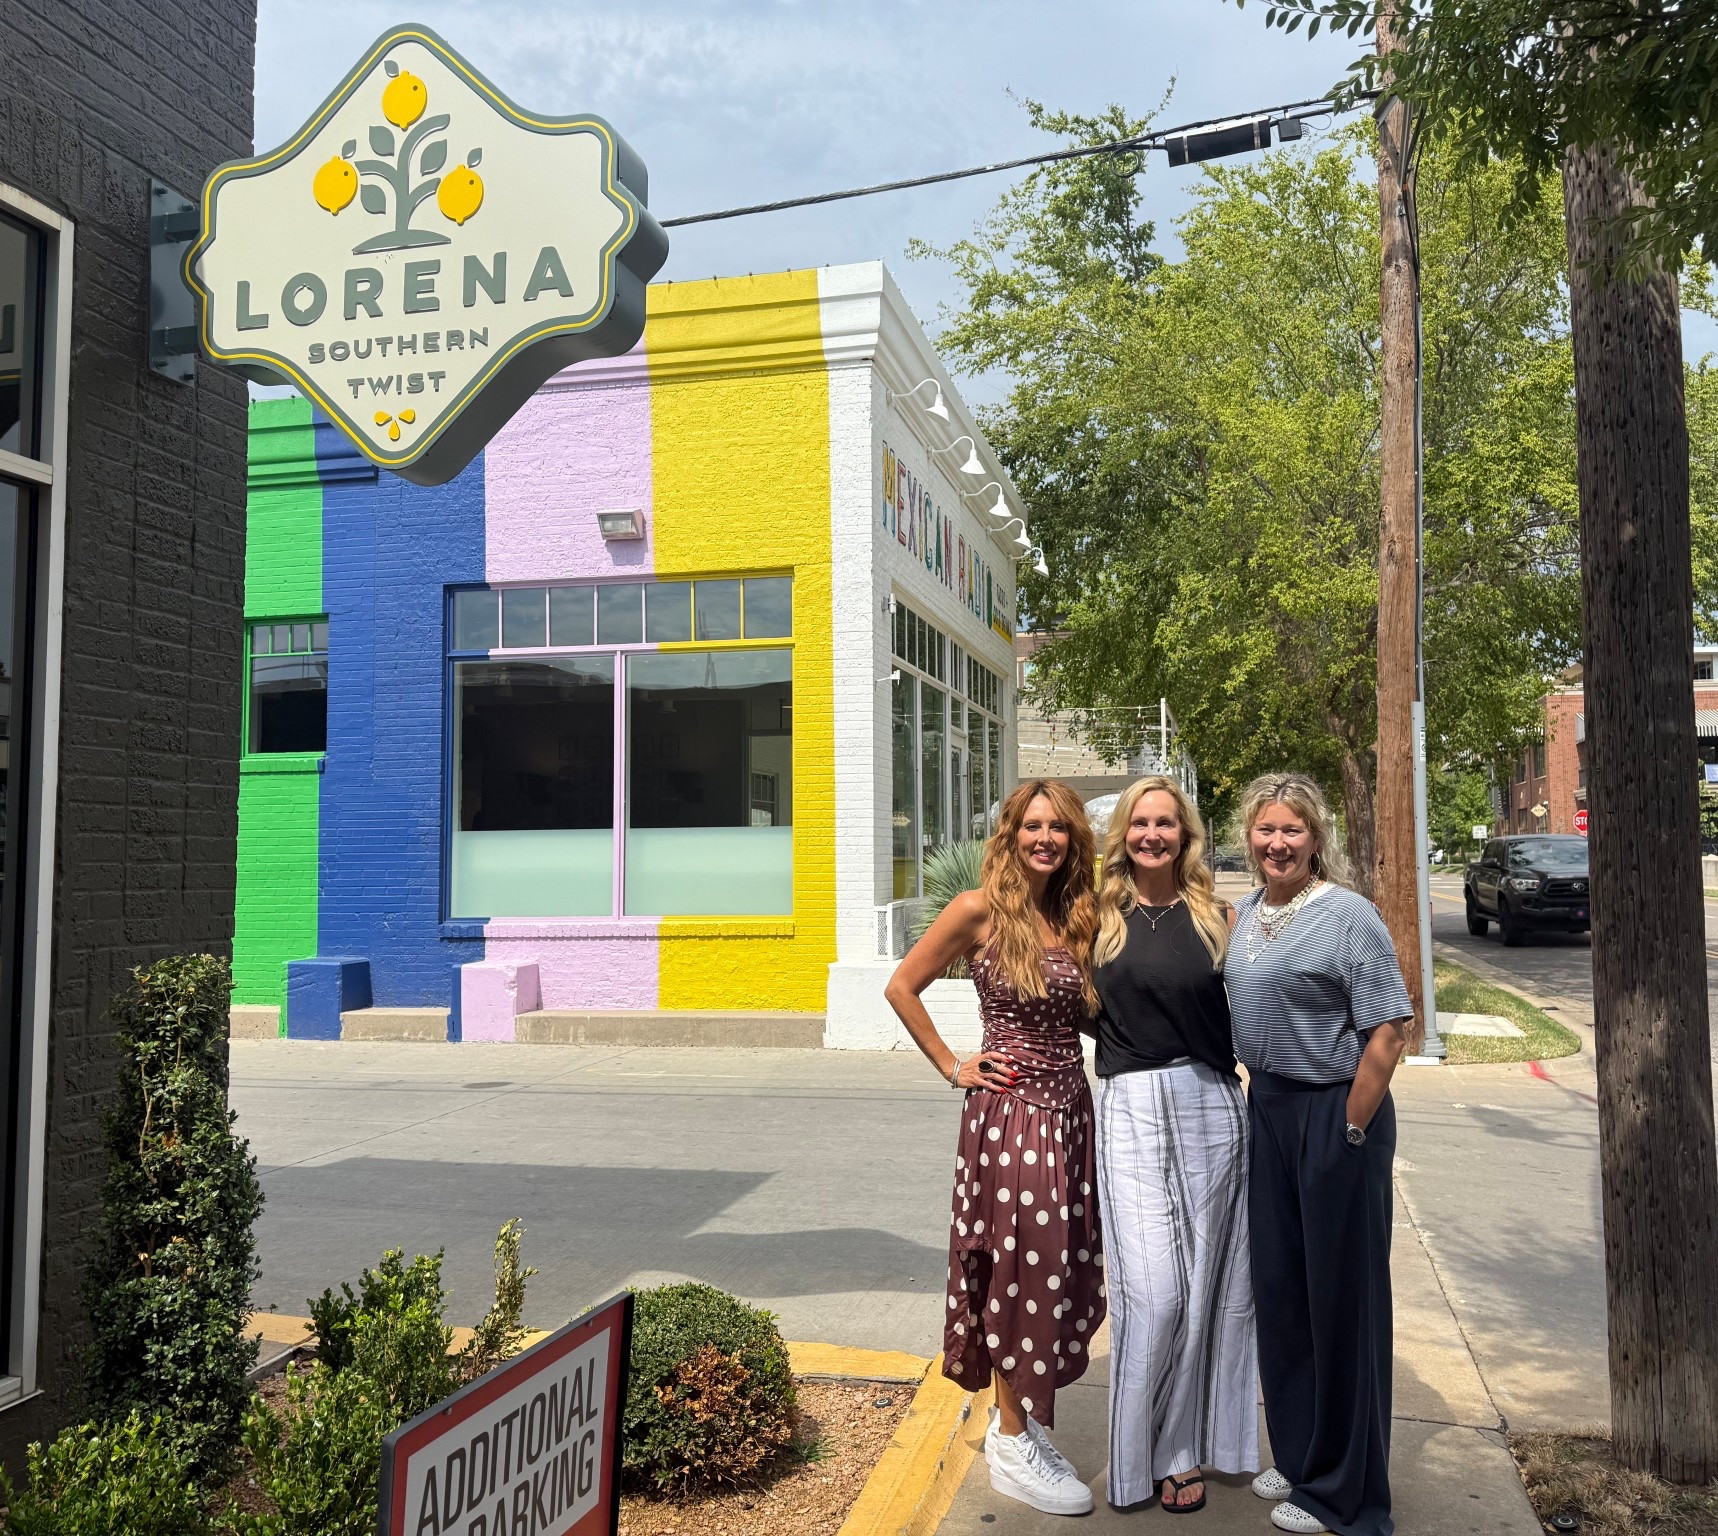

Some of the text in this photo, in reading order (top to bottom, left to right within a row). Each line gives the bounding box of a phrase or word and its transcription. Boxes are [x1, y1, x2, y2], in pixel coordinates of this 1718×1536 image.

[236, 246, 574, 331] LORENA
[308, 327, 489, 364] SOUTHERN
[347, 371, 446, 399] TWIST
[882, 439, 993, 630] MEXICAN RADIO
[1575, 816, 1588, 826] ST
[415, 1357, 598, 1536] ADDITIONAL
